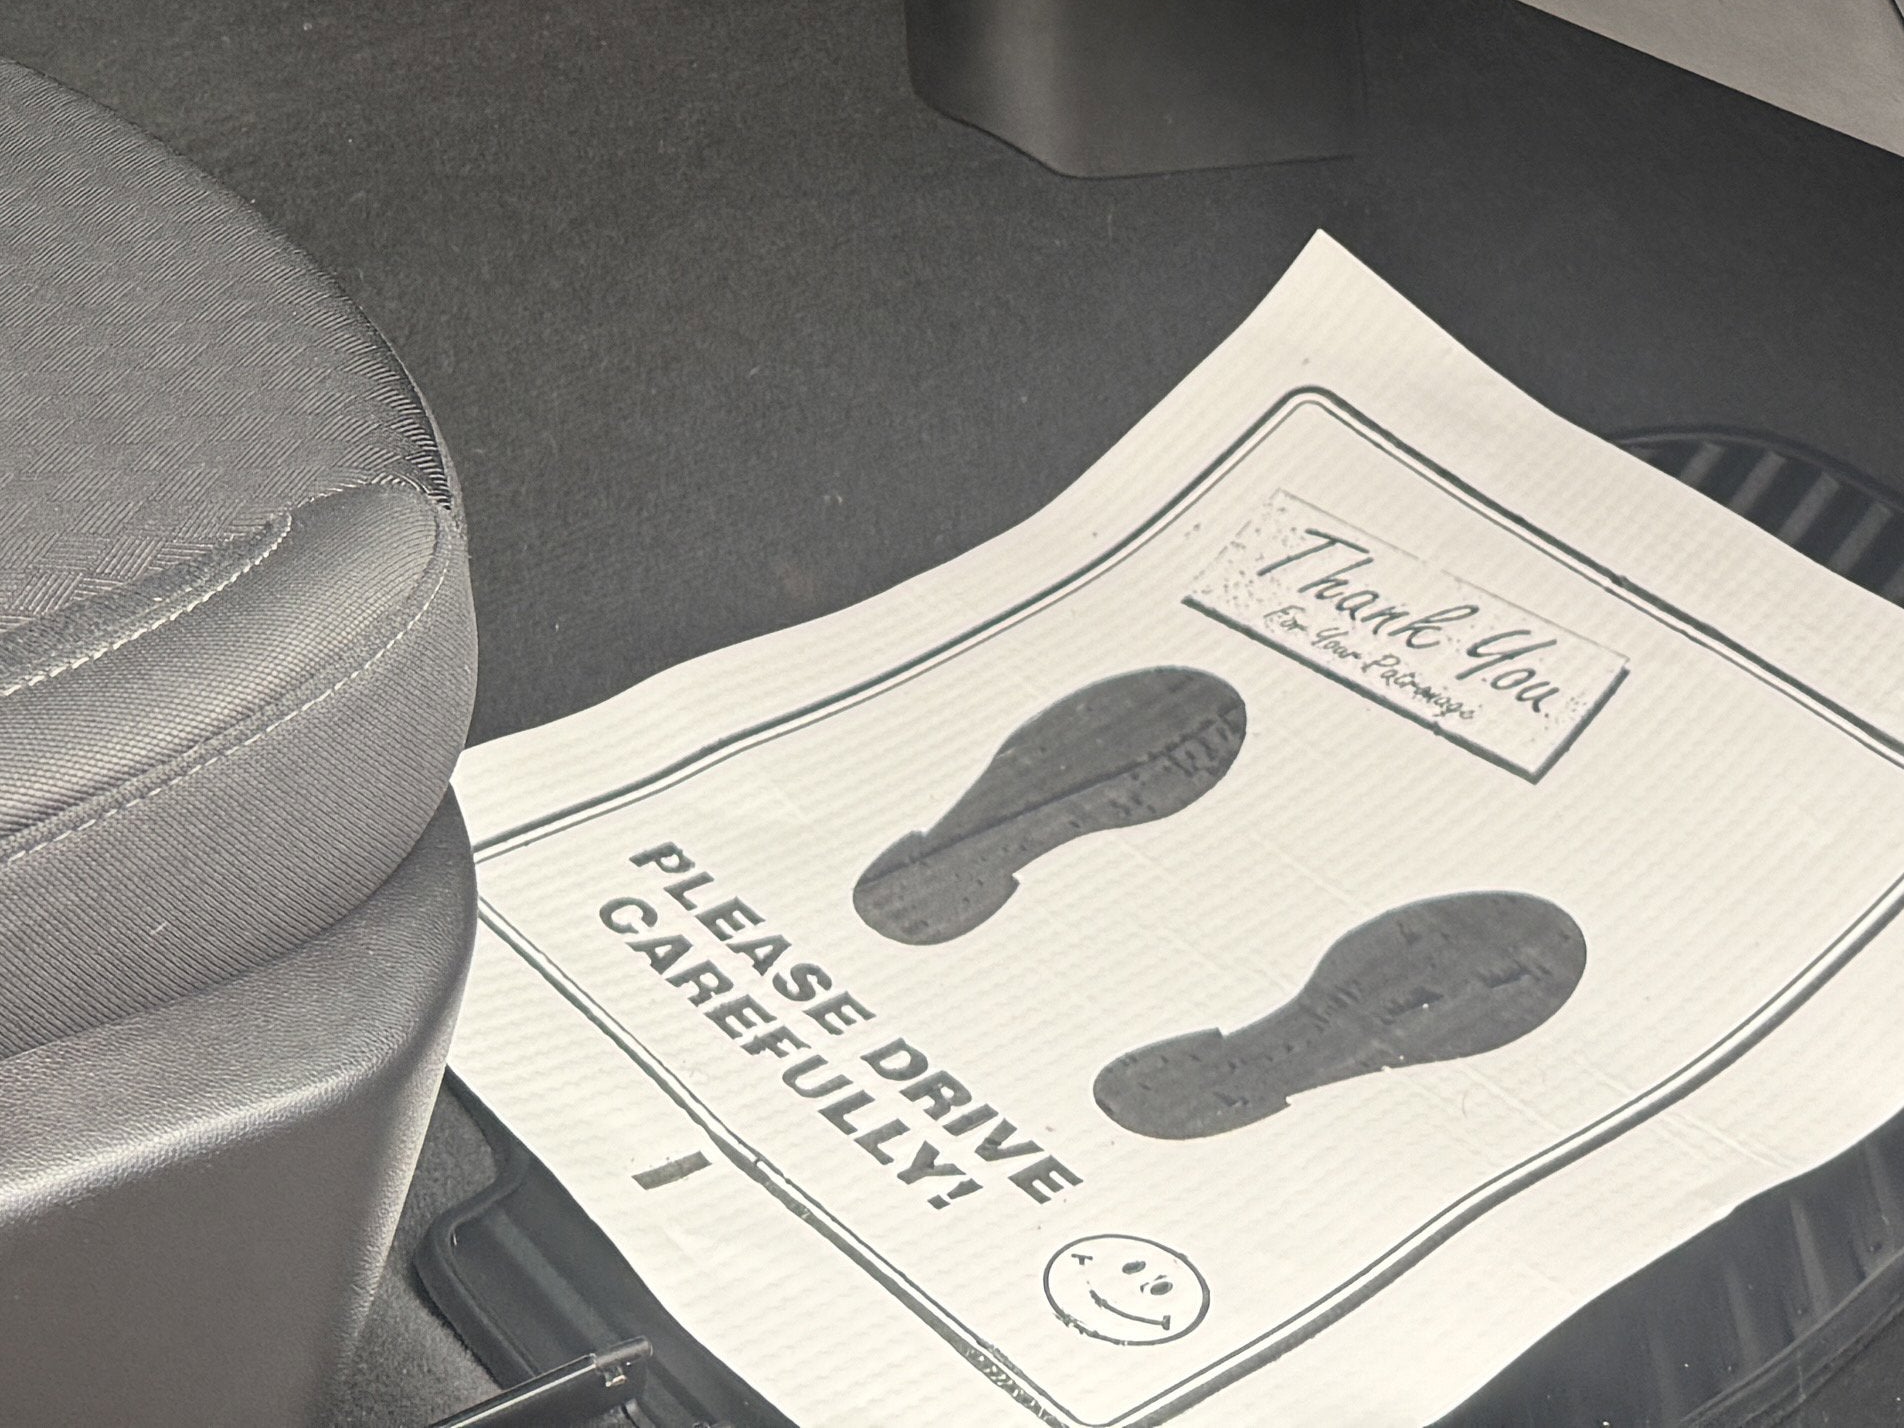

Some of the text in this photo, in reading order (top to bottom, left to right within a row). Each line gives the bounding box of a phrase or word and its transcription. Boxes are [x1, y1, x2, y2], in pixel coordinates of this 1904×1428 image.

[1256, 527, 1480, 651] Thank
[1263, 604, 1309, 633] For
[1310, 626, 1362, 661] Your
[598, 895, 984, 1211] CAREFULLY!
[628, 840, 1084, 1206] PLEASE DRIVE
